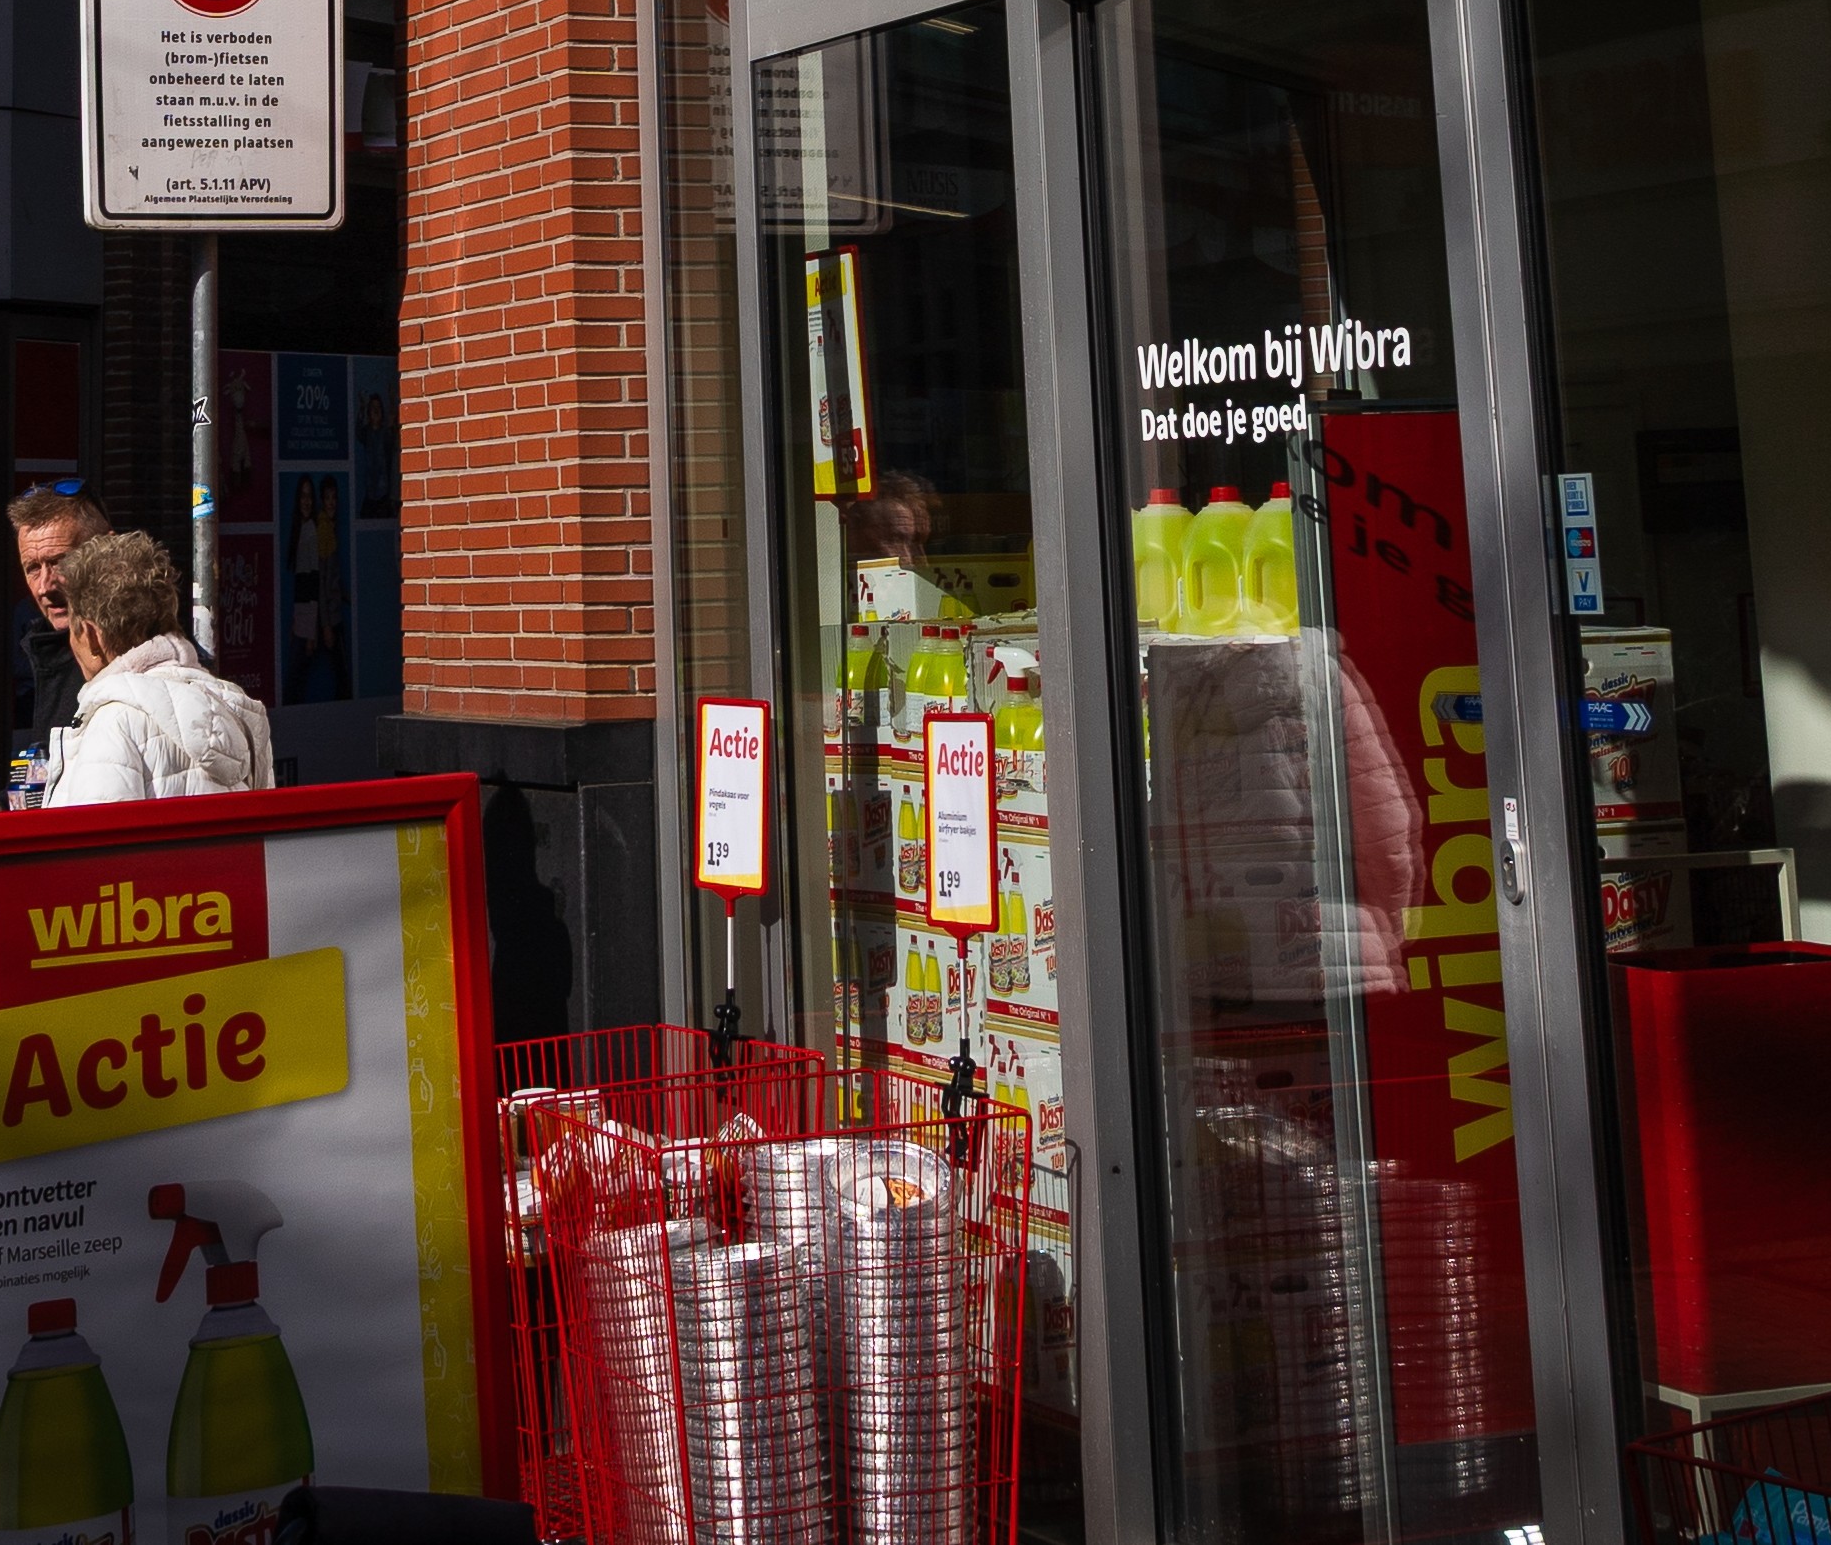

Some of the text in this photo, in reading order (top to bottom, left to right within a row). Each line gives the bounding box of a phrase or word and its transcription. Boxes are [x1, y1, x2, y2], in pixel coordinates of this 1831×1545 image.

[161, 30, 272, 45] Het is verboden
[165, 51, 269, 68] (brom-)fietsen
[149, 72, 285, 86] onbeheerd te laten
[155, 93, 279, 107] staan m.u.v. in de
[163, 114, 272, 131] fietsstalling en
[141, 135, 294, 152] aangewezen plaatsen
[166, 177, 271, 194] (art. 5.1.11 APV)
[143, 194, 293, 206] Algemene Plaatselijke Verordening
[1137, 318, 1411, 390] Welkom bij Wibra
[296, 384, 329, 411] 20%
[1140, 393, 1307, 445] Dat doe je goed
[1579, 597, 1593, 608] PAY
[1587, 703, 1614, 714] FAAC
[709, 727, 759, 760] Actie
[937, 740, 984, 777] Actie
[709, 788, 750, 800] Pindakaas voor
[709, 800, 726, 811] vogels
[938, 825, 977, 837] airfryer bakjes
[708, 842, 730, 867] 1.39
[939, 871, 961, 897] 1.99
[28, 882, 234, 953] wibra
[1033, 904, 1054, 937] Das
[2, 993, 267, 1127] Actie
[23, 1205, 84, 1234] navul
[7, 1238, 81, 1265] Marseille
[84, 1235, 123, 1256] zeep
[42, 1265, 91, 1284] mogelijk
[214, 1501, 256, 1530] classic
